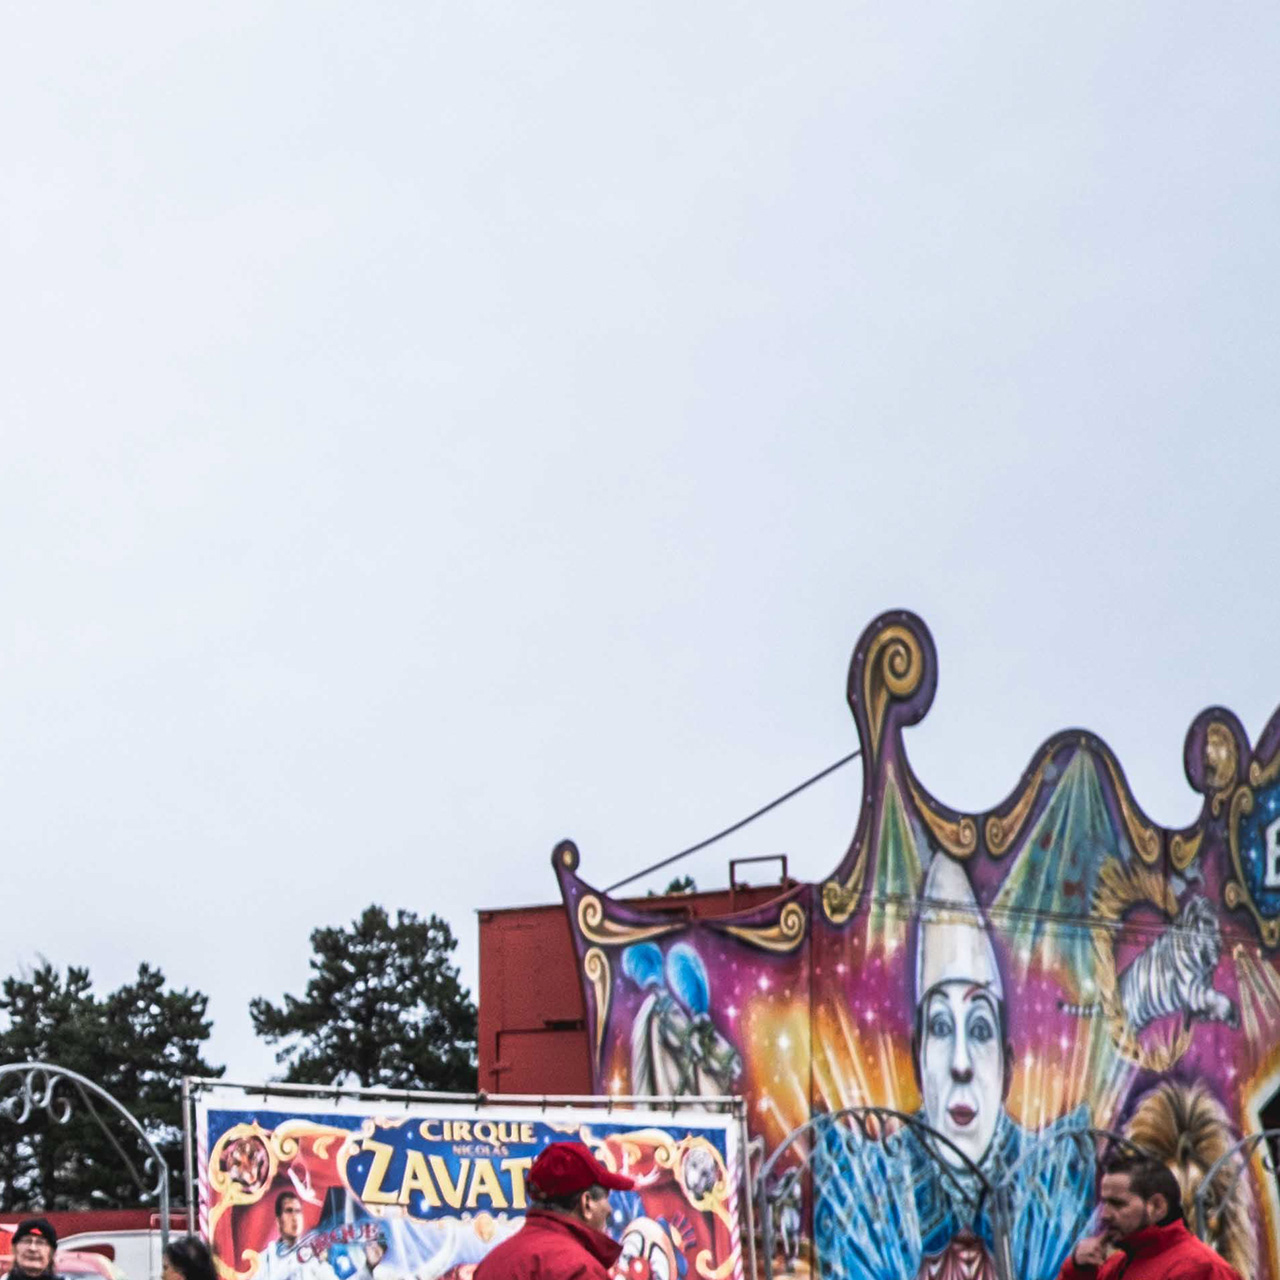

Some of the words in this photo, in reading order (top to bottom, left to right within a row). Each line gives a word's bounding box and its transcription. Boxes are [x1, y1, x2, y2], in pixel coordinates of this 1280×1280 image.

[419, 1119, 538, 1147] CIRQUE
[453, 1144, 509, 1157] NICOLAS
[361, 1138, 536, 1210] ZAVAT
